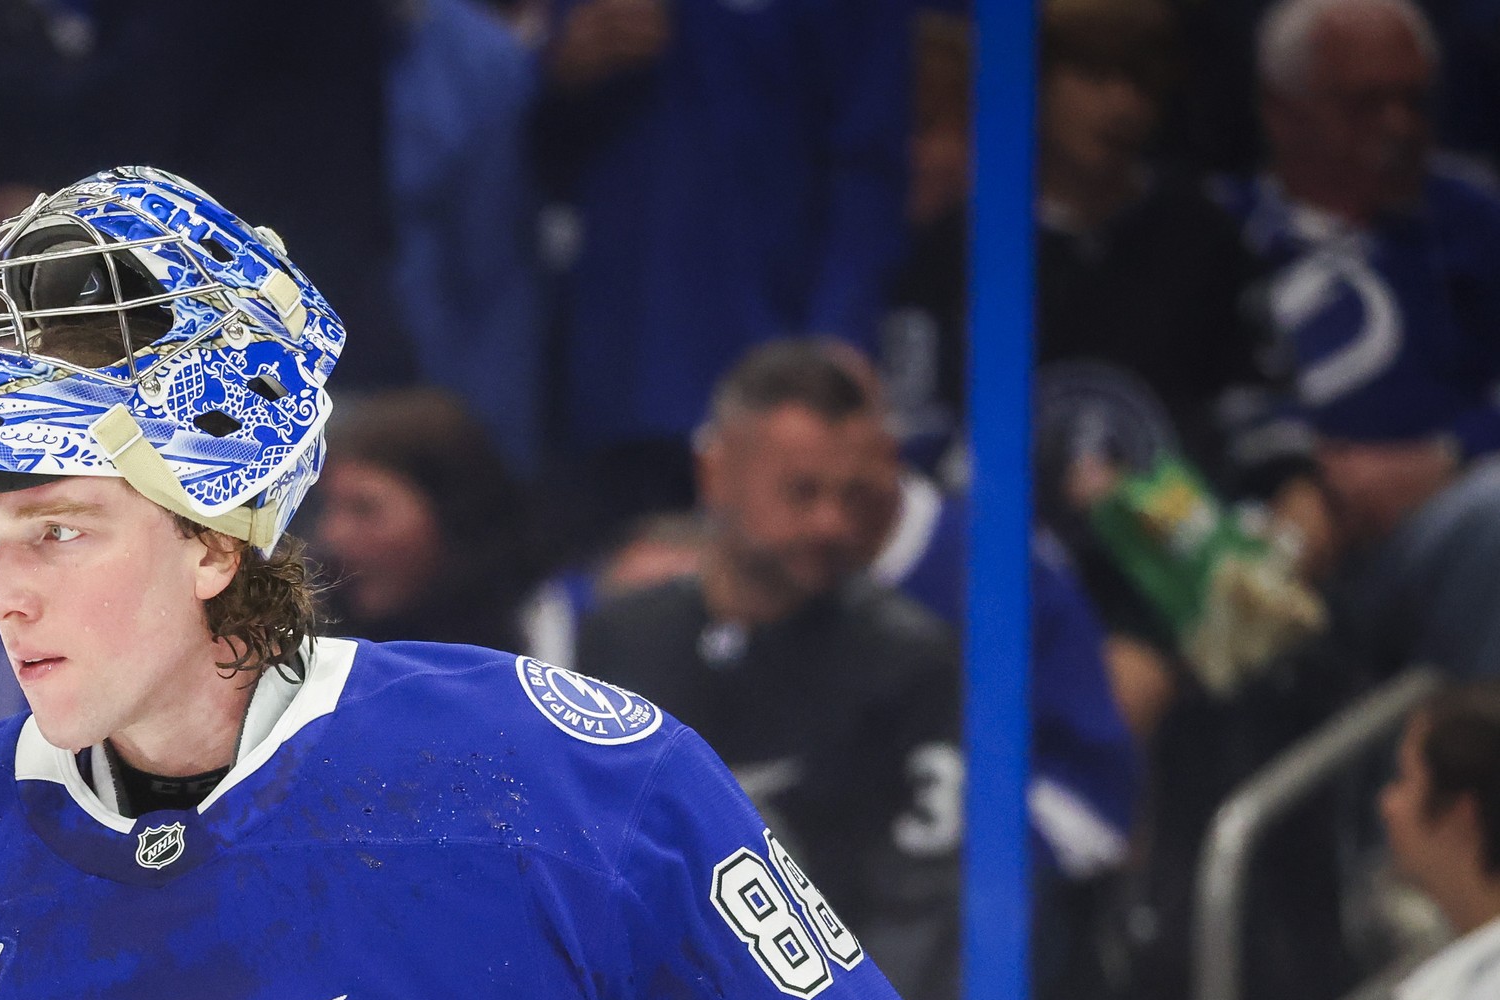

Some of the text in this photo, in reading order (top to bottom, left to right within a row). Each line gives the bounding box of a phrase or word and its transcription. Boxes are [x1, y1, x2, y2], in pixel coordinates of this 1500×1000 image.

[541, 691, 609, 735] TAMPA
[146, 833, 176, 861] NHL
[710, 828, 864, 1000] 88
